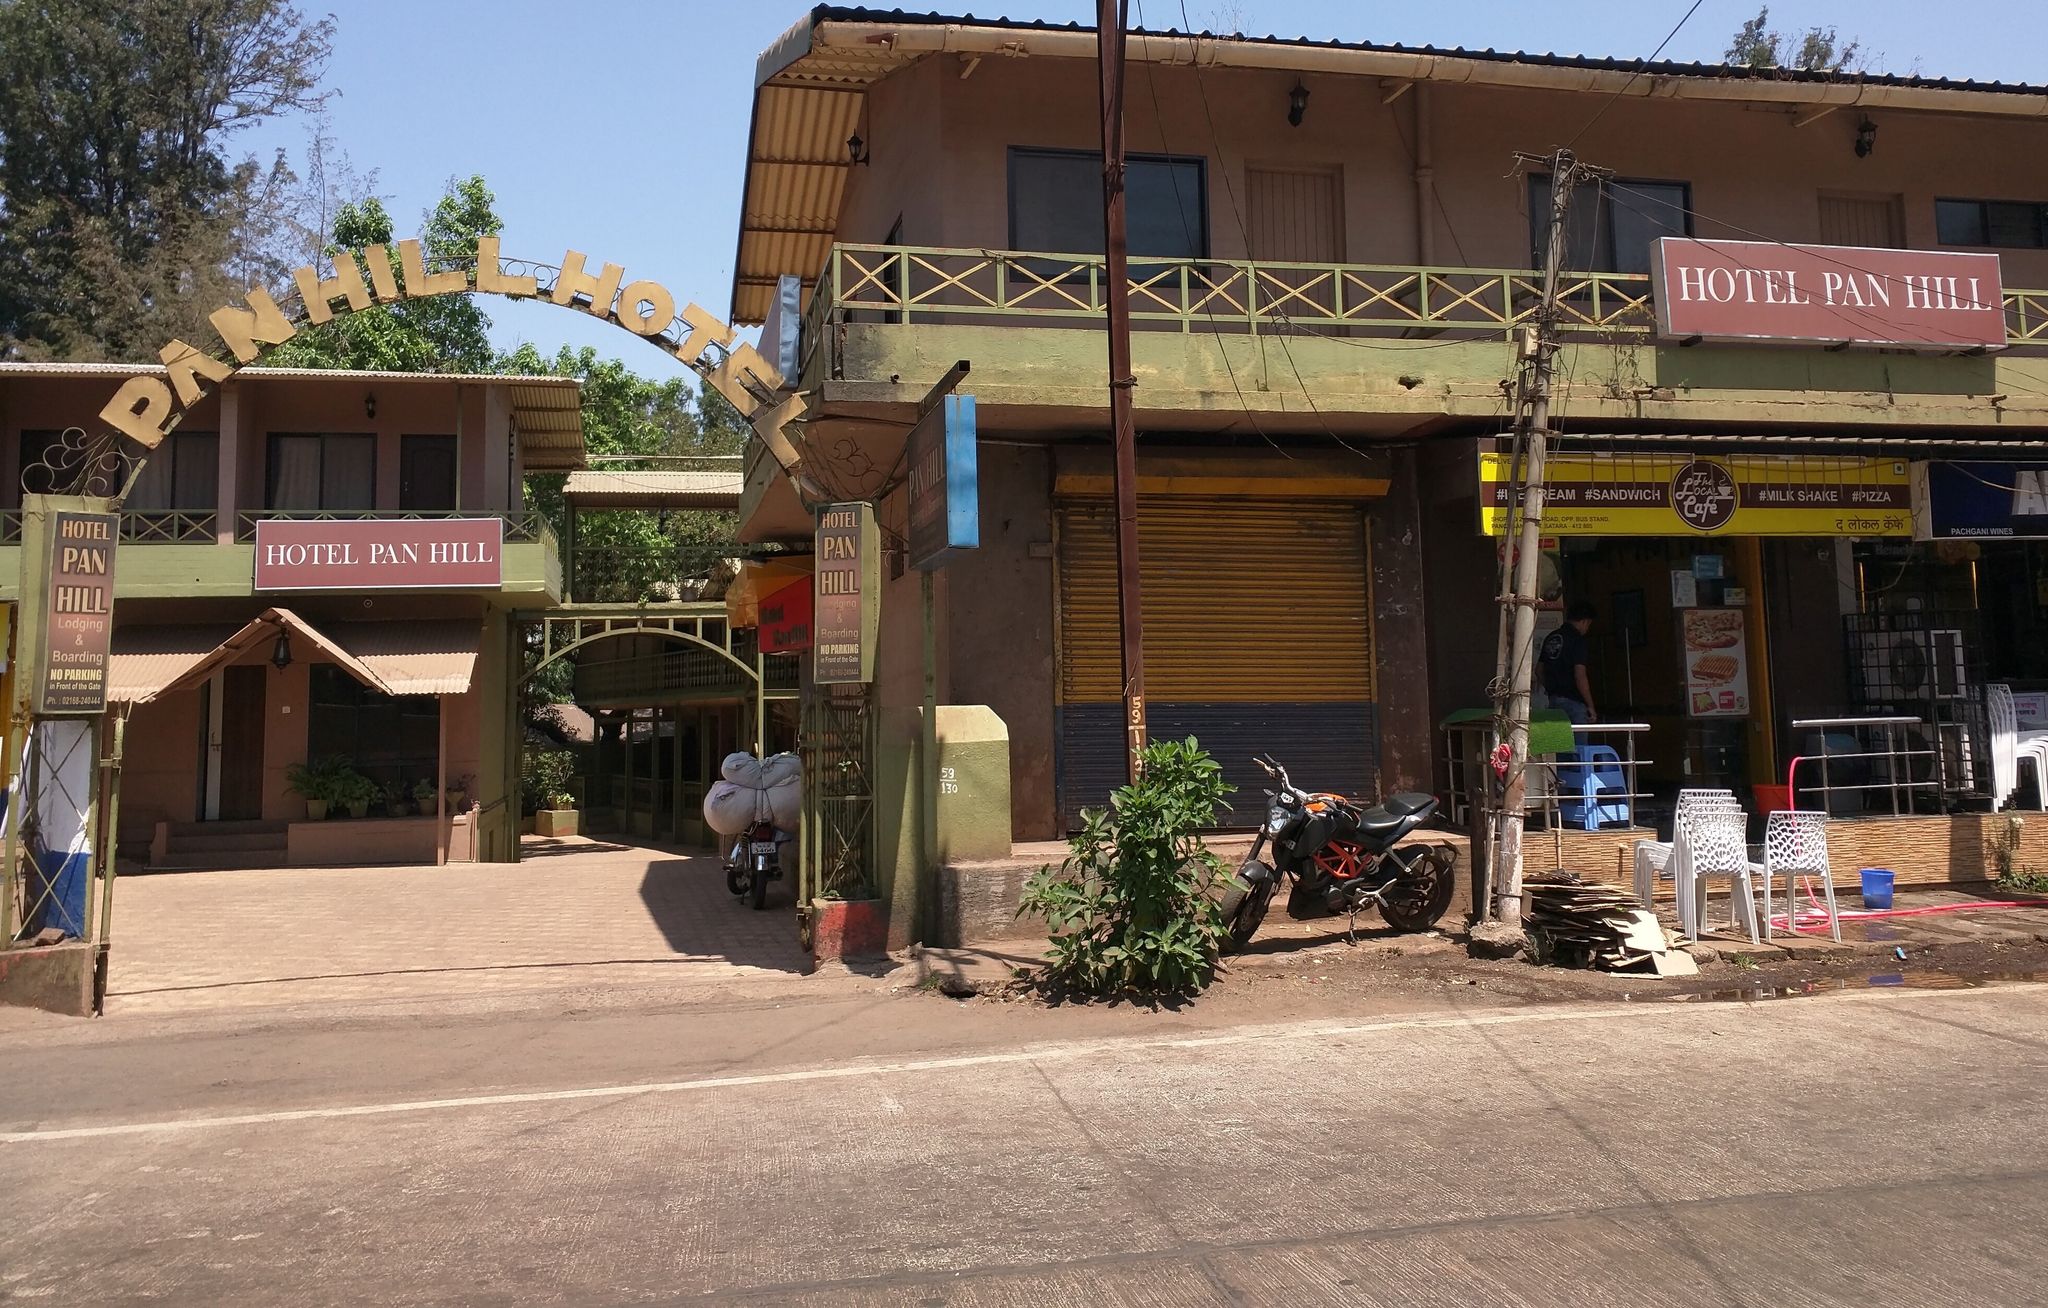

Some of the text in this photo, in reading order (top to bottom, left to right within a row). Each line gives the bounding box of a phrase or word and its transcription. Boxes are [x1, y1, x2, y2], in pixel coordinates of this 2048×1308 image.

[1677, 266, 1993, 311] HOTEL PAN HILL
[98, 236, 808, 470] PAN HILL HOTEL
[1496, 488, 1892, 503] #IE REAM #SANDWICH #MILK SHAKE #PIZZA
[822, 511, 859, 529] HOTEL
[1847, 514, 1880, 531] लोकल
[62, 519, 111, 541] HOTEL
[1950, 527, 2014, 536] PACHGANI WINES
[265, 541, 494, 566] HOTEL PAN HILL
[823, 535, 856, 560] PAN
[62, 546, 106, 575] PAN
[821, 570, 859, 595] HILL
[57, 586, 107, 614] HILL
[57, 617, 103, 632] Lodging
[75, 633, 83, 646] &
[821, 627, 859, 640] Boarding
[820, 643, 860, 655] NO PARKING
[52, 650, 104, 666] Boarding
[50, 668, 103, 681] NO PARKING
[49, 682, 102, 691] in Front of the Gate
[941, 767, 955, 779] 59
[941, 782, 958, 794] 130
